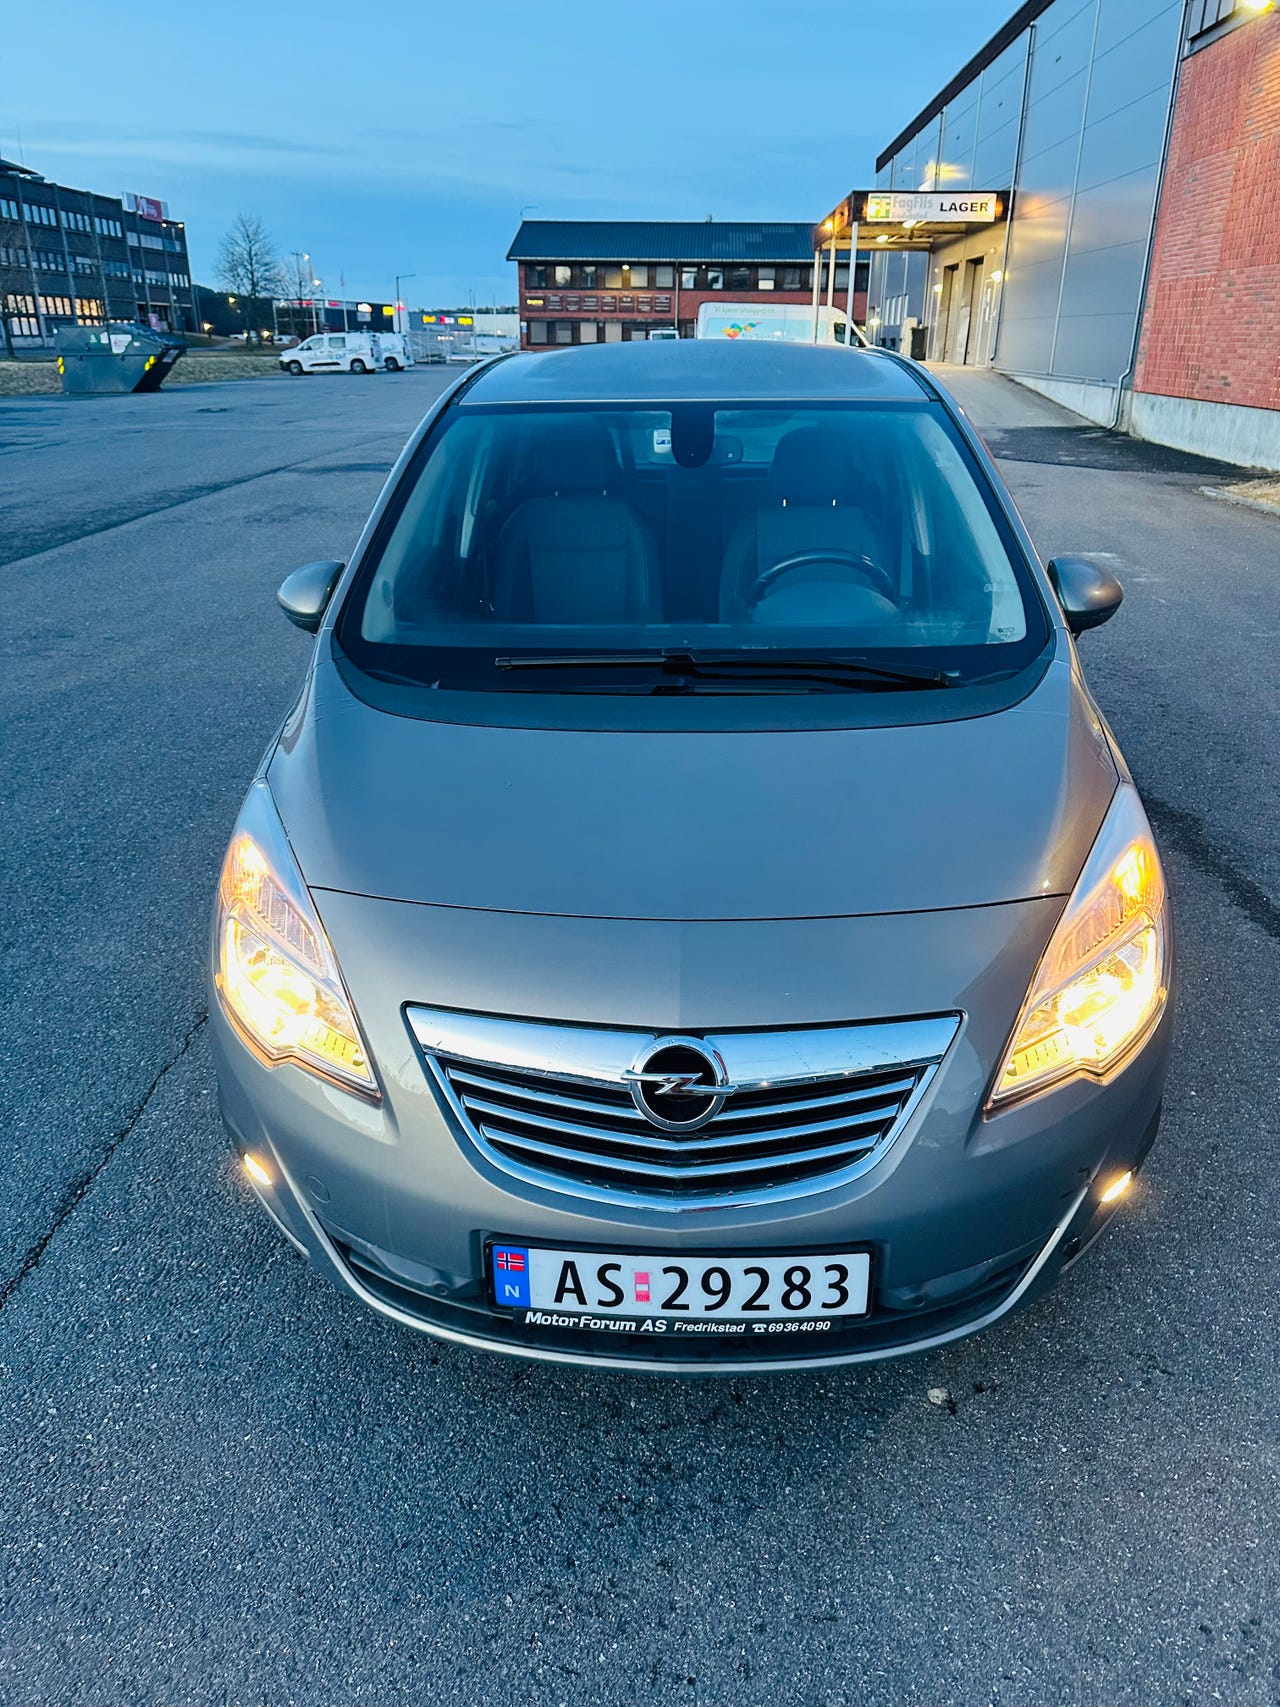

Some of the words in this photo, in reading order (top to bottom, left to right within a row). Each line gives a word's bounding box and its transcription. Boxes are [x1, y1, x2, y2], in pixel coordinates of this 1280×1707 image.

[893, 195, 933, 211] FagFlis
[939, 202, 988, 212] LAGER
[505, 1284, 520, 1298] N
[553, 1260, 625, 1308] AS
[660, 1263, 849, 1312] 29283
[640, 1319, 667, 1332] AS
[674, 1321, 746, 1333] Fredrikstad
